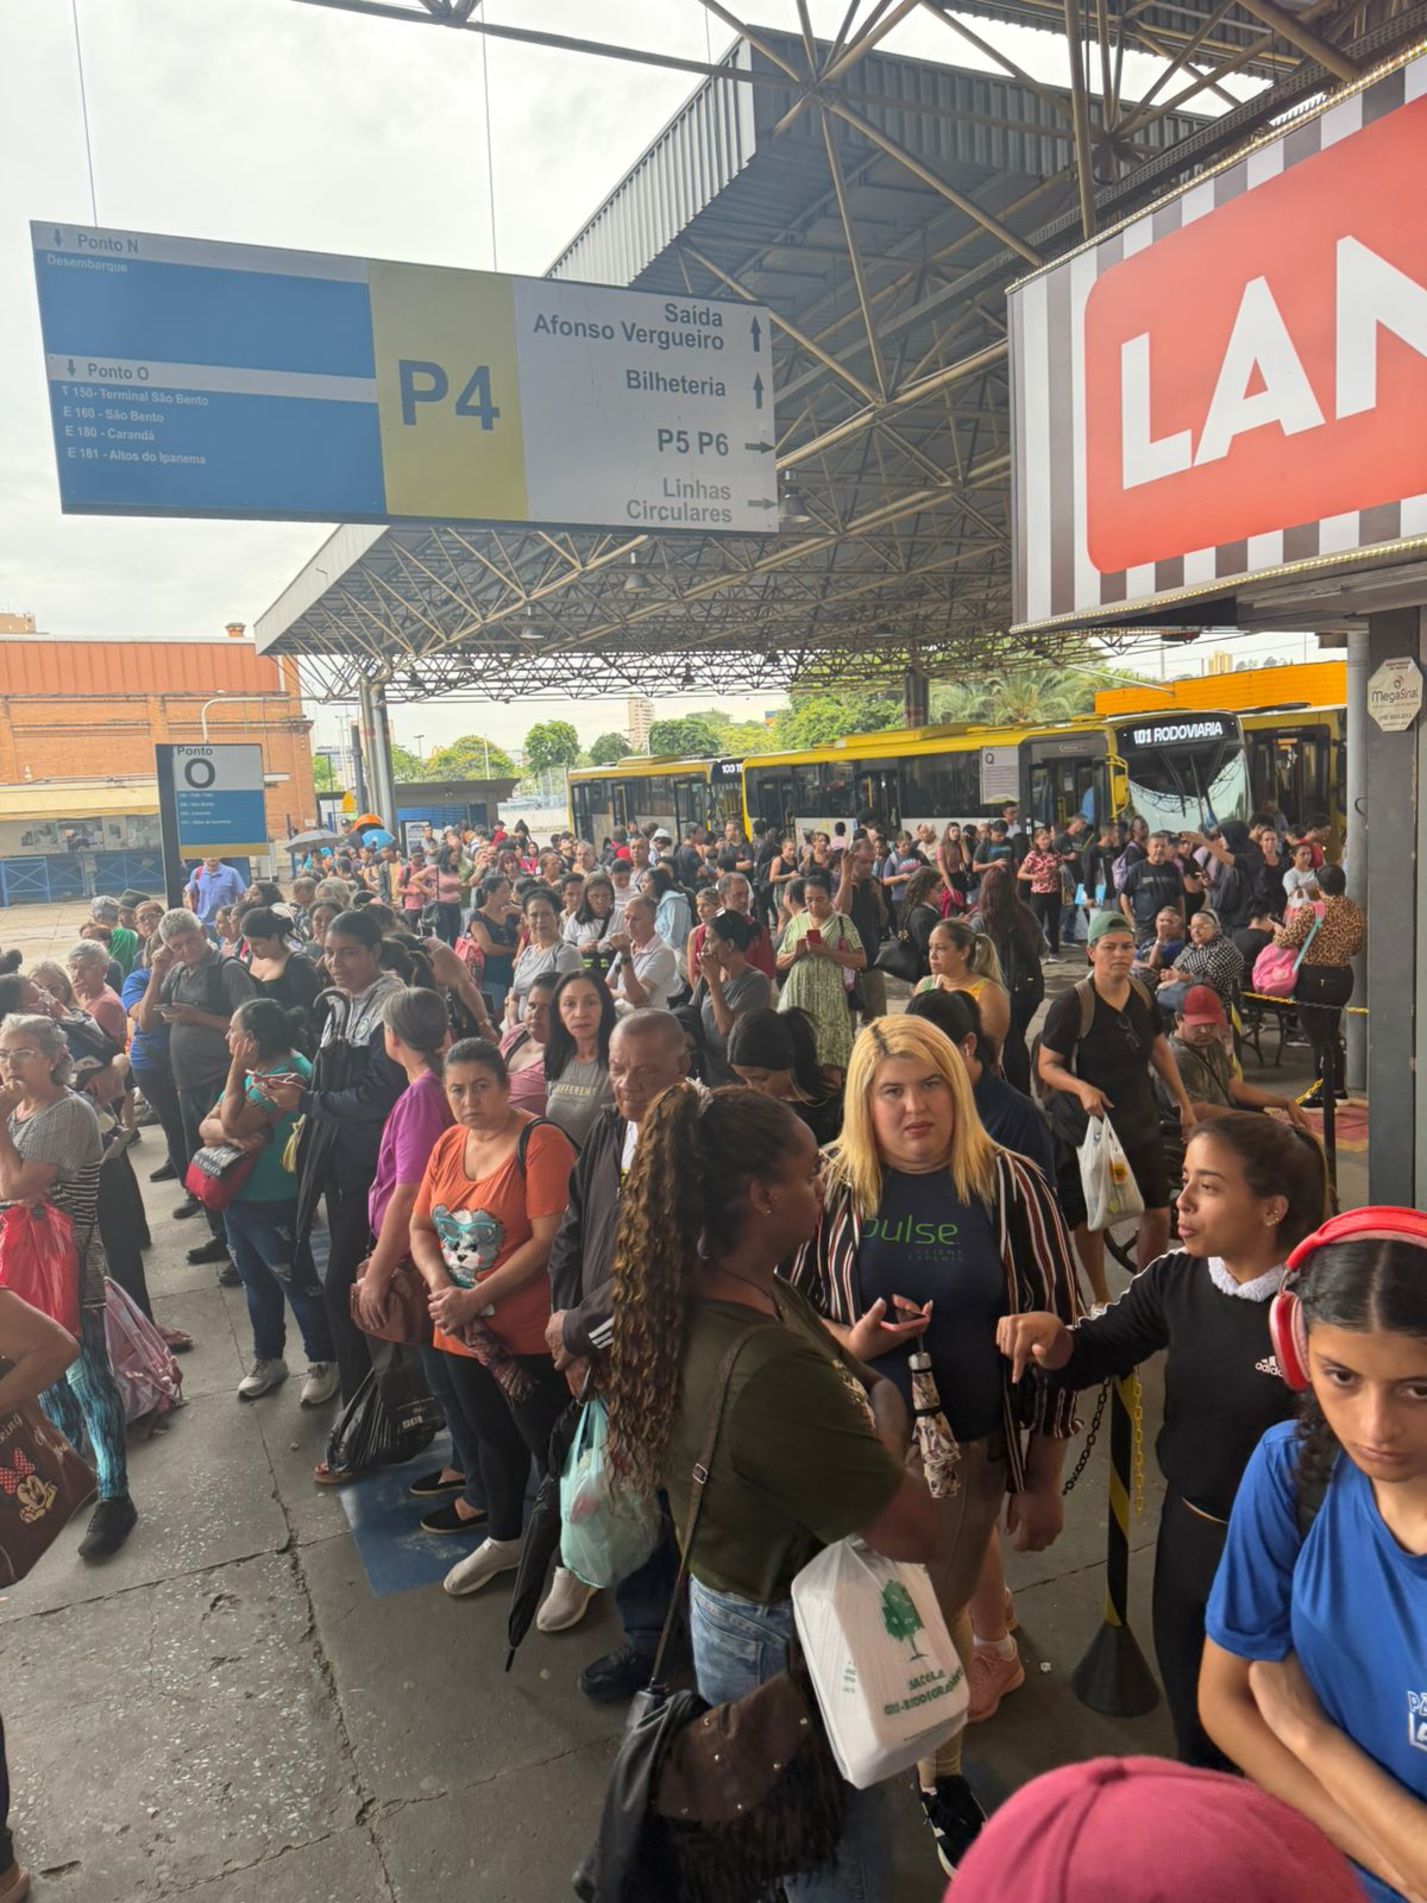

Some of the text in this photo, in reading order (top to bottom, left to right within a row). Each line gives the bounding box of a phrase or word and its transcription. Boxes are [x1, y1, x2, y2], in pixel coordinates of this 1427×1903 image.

[78, 233, 138, 253] Ponto N
[47, 253, 128, 273] Desembarque
[664, 302, 723, 327] Saída
[533, 313, 724, 350] Afonso Vergueiro
[88, 363, 149, 381] Ponto O
[626, 369, 726, 397] Bilheteria
[62, 386, 69, 396] T
[100, 388, 149, 401] Terminal
[151, 391, 174, 404] São
[176, 394, 208, 406] Bento
[398, 358, 501, 431] P4
[63, 406, 72, 417] E
[76, 407, 95, 418] 160
[105, 408, 128, 421] São
[130, 410, 164, 423] Bento
[65, 425, 74, 437] E
[77, 426, 97, 438] 180
[107, 428, 155, 441] Carandá
[657, 428, 729, 456] P5 P6
[67, 447, 76, 458] E
[80, 448, 99, 459] 181
[109, 450, 139, 461] Altos
[142, 451, 157, 462] do
[160, 453, 206, 465] Ipanema
[662, 477, 732, 501] Linhas
[626, 500, 733, 523] Circulares
[1153, 721, 1224, 743] RODOVIARIA
[177, 746, 213, 756] Ponto
[985, 752, 995, 765] Q
[184, 757, 215, 789] O
